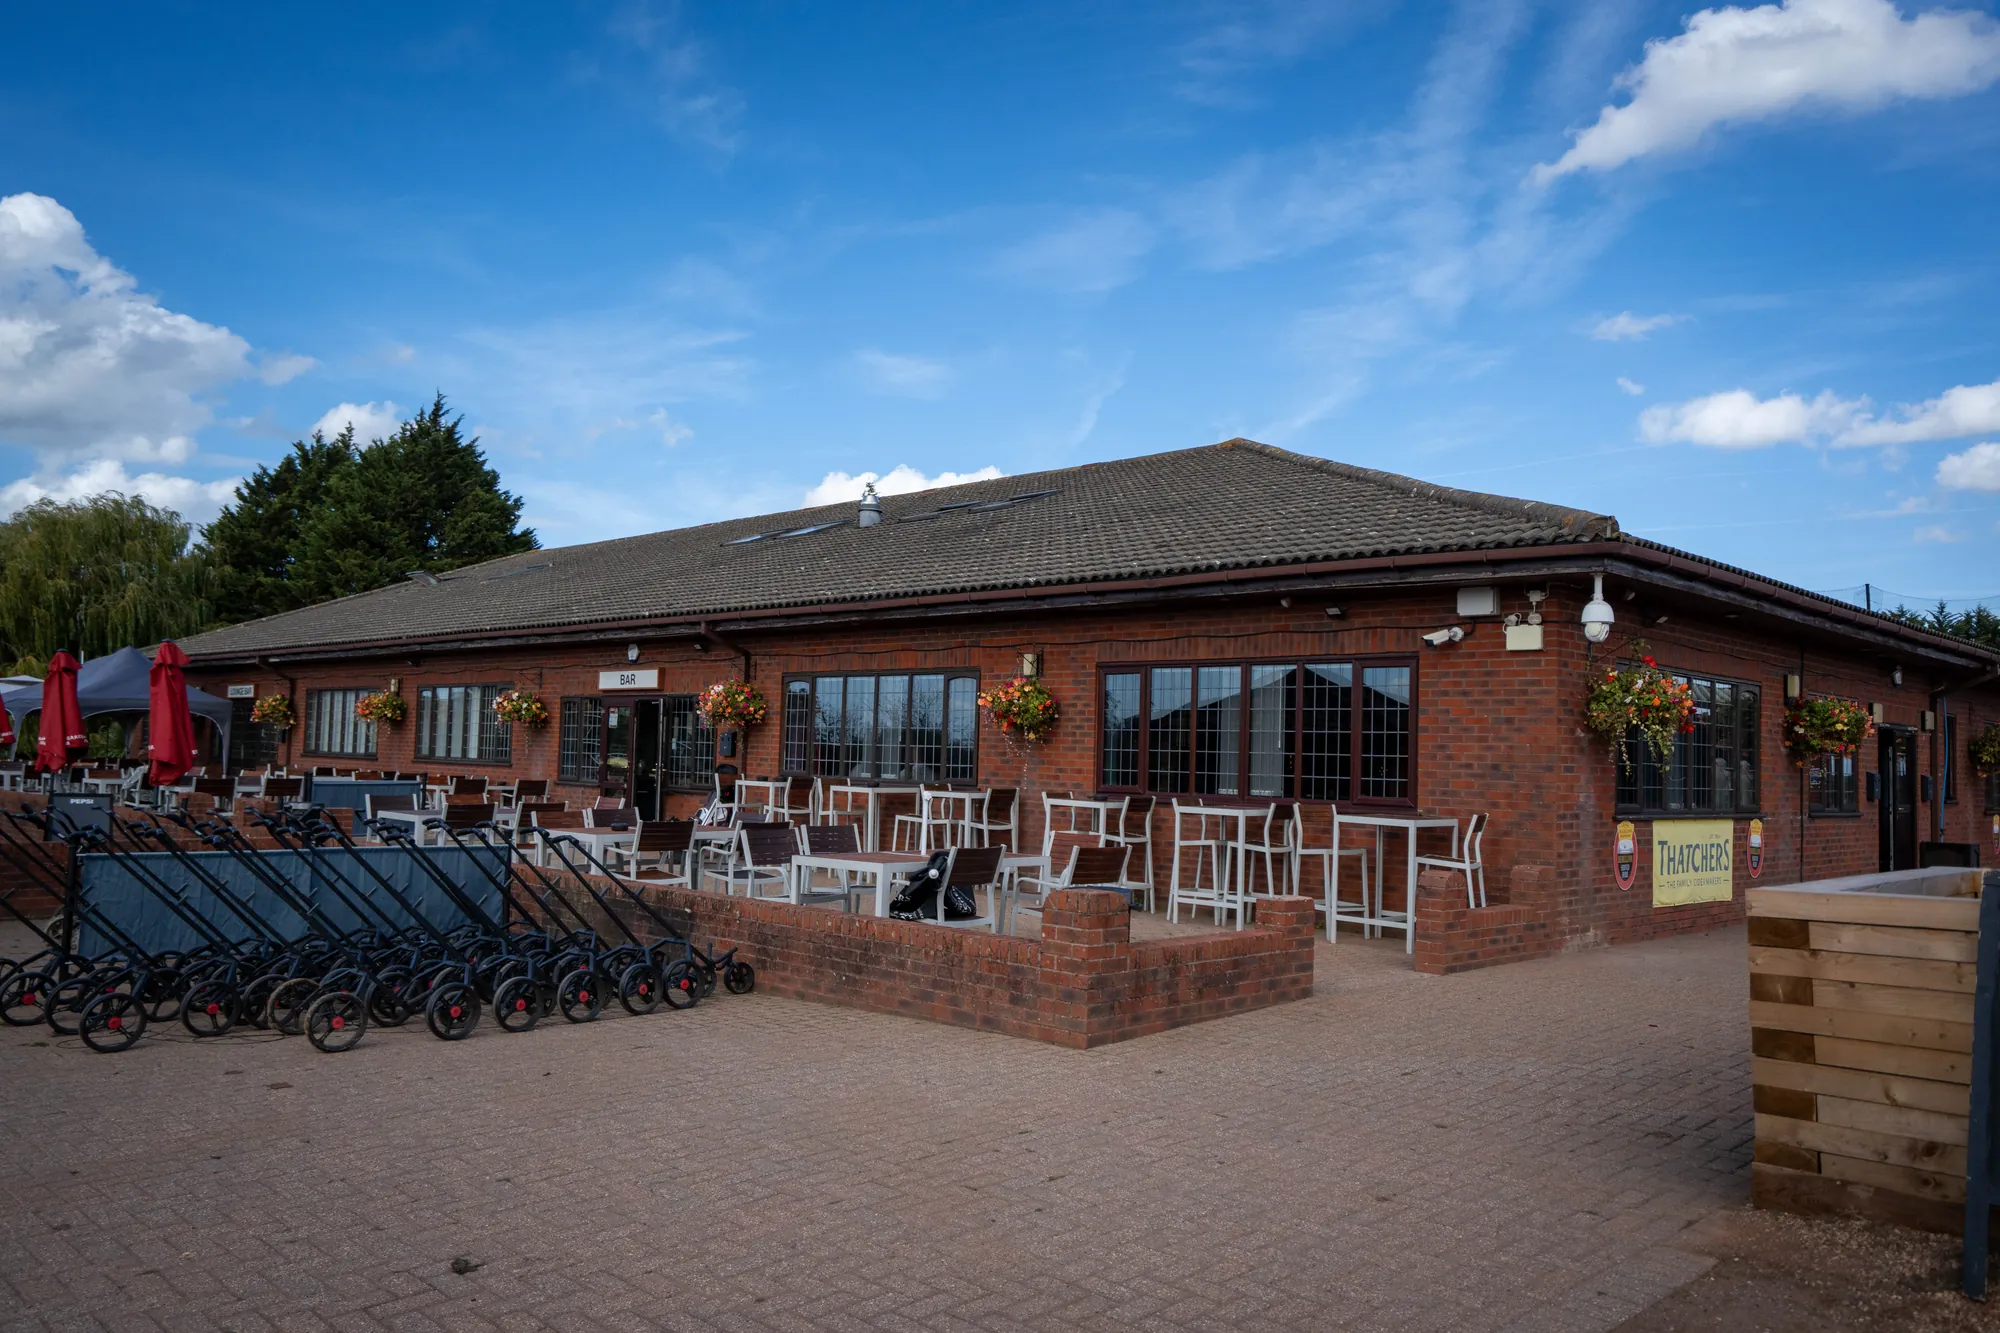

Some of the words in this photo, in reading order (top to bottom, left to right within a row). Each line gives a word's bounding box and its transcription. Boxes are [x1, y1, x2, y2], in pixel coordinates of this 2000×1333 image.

[620, 674, 636, 685] BAR
[1657, 838, 1730, 876] THATCHERS
[1667, 881, 1676, 889] THE
[1676, 879, 1692, 887] FAMILY
